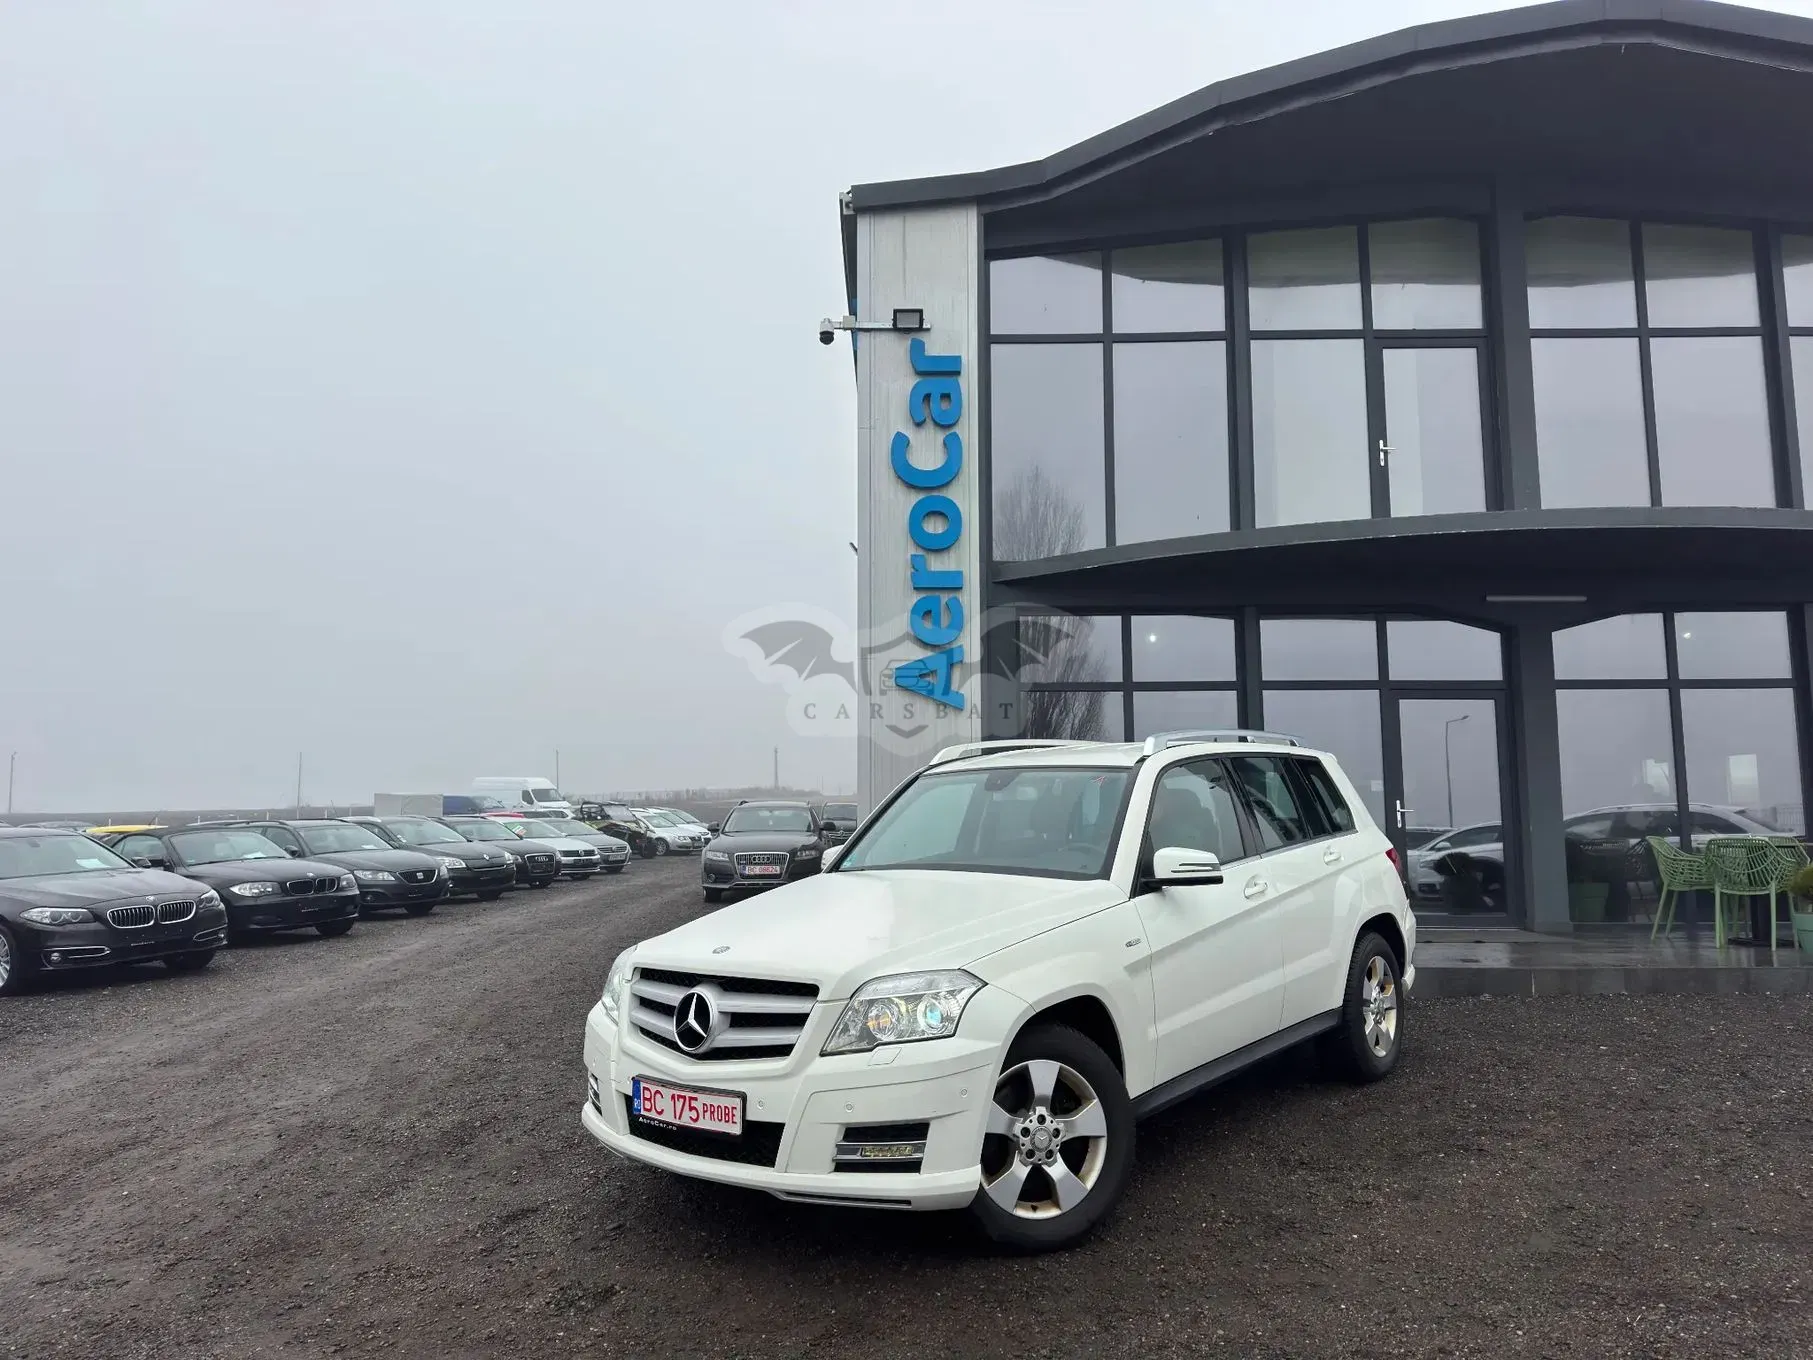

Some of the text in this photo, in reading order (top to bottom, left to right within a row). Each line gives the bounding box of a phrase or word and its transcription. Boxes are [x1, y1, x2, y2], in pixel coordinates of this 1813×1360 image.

[890, 338, 965, 711] AeroCar
[642, 1086, 737, 1124] BC 175 PROBE
